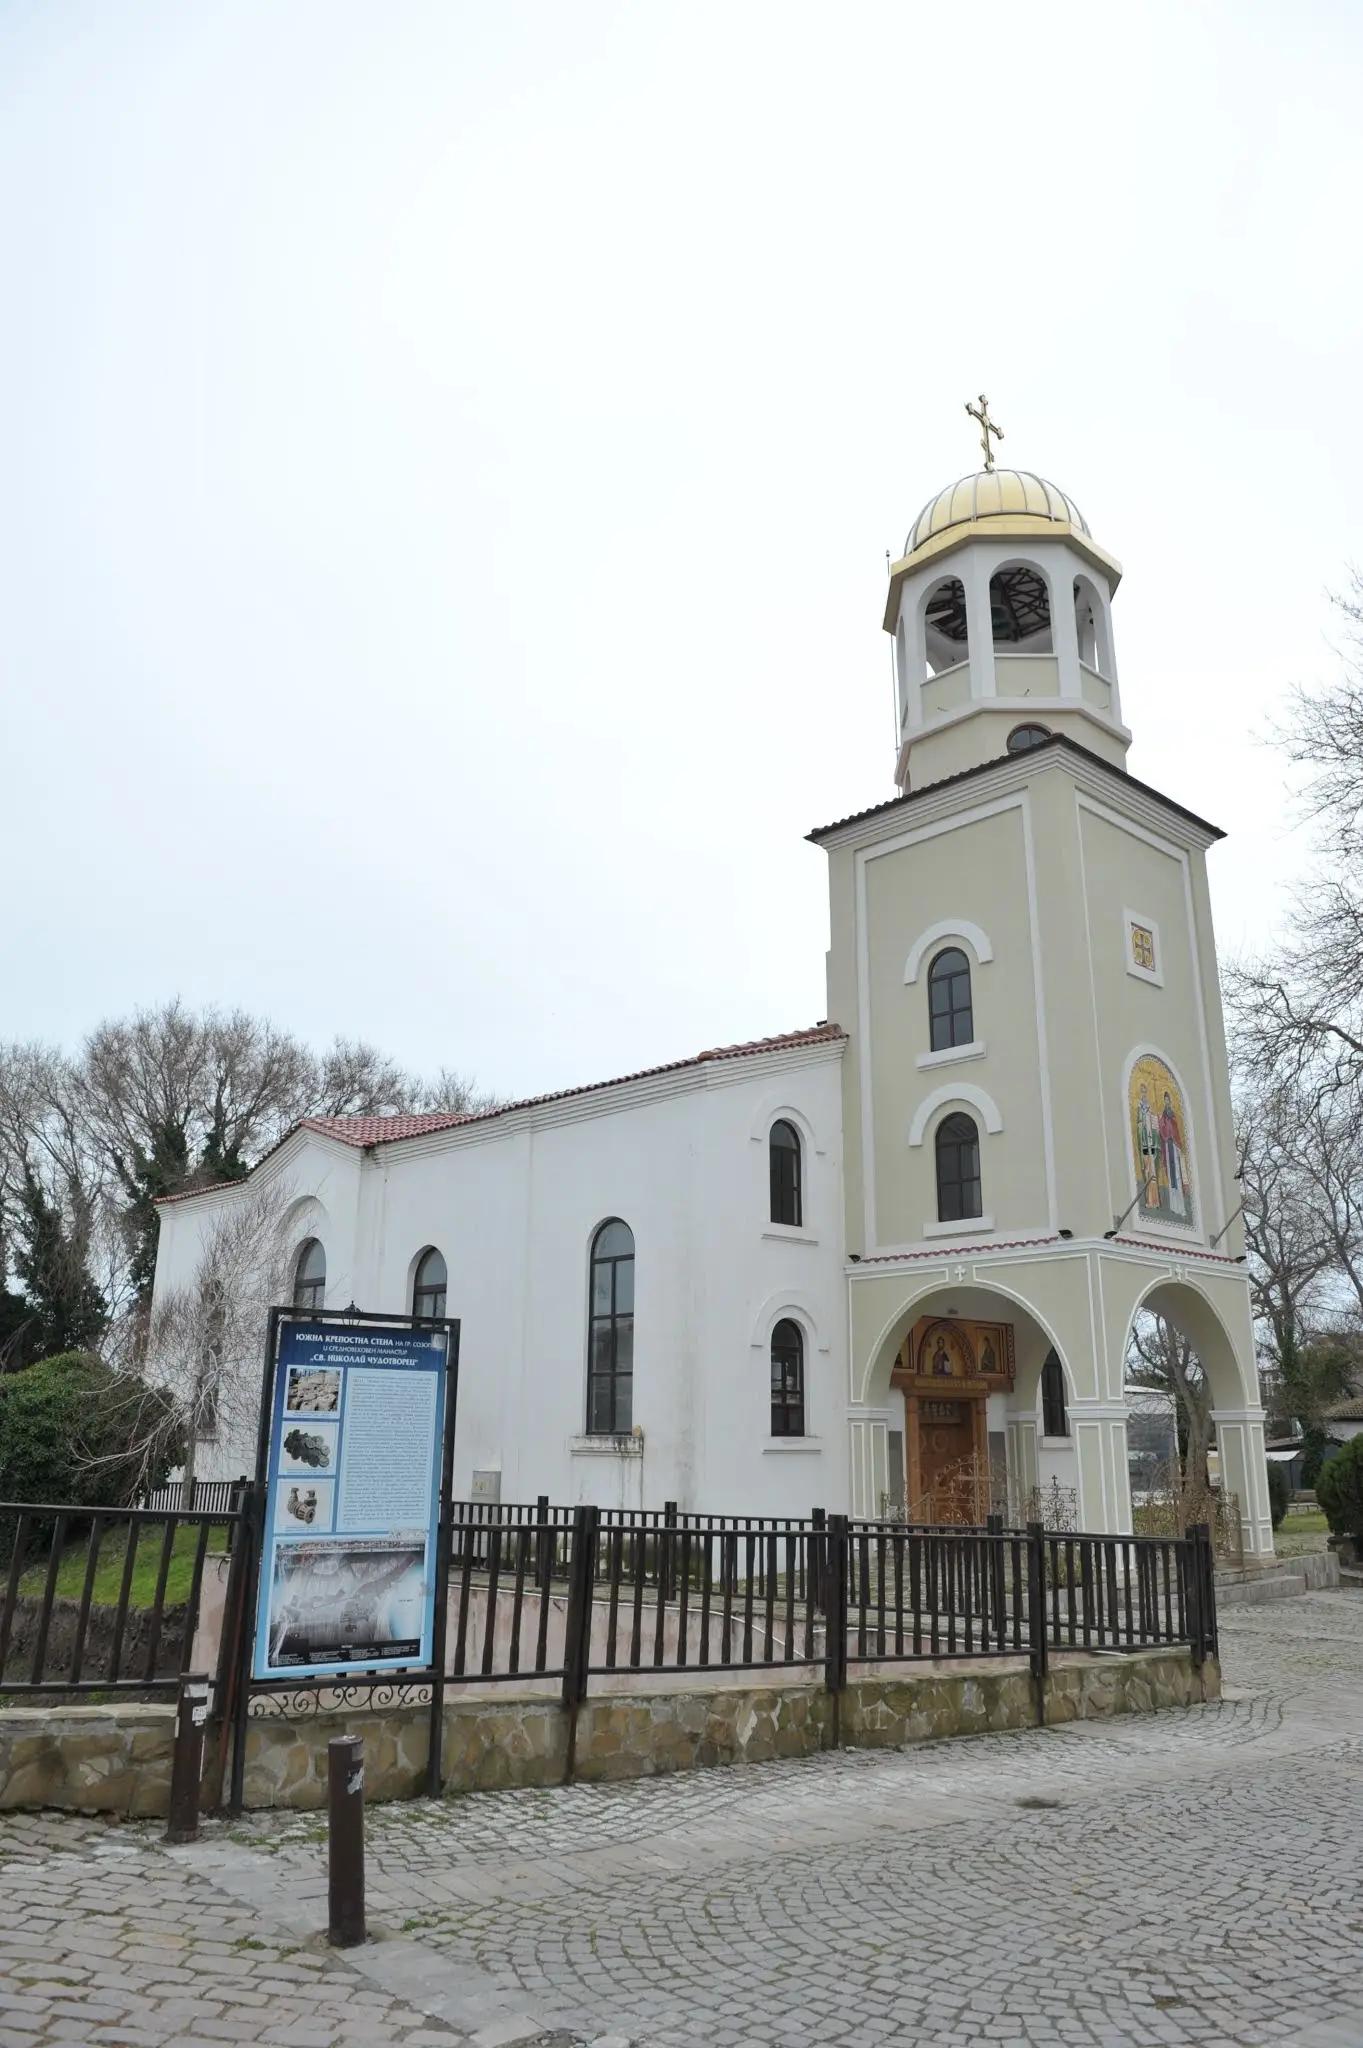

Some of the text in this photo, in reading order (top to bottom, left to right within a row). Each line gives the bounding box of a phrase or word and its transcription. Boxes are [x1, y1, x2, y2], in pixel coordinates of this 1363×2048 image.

[295, 1333, 323, 1342] ЮЖНА
[325, 1335, 369, 1345] КРЕПОСТНА
[370, 1337, 394, 1346] СТЕНА
[327, 1354, 366, 1363] НИКОЛАЙ
